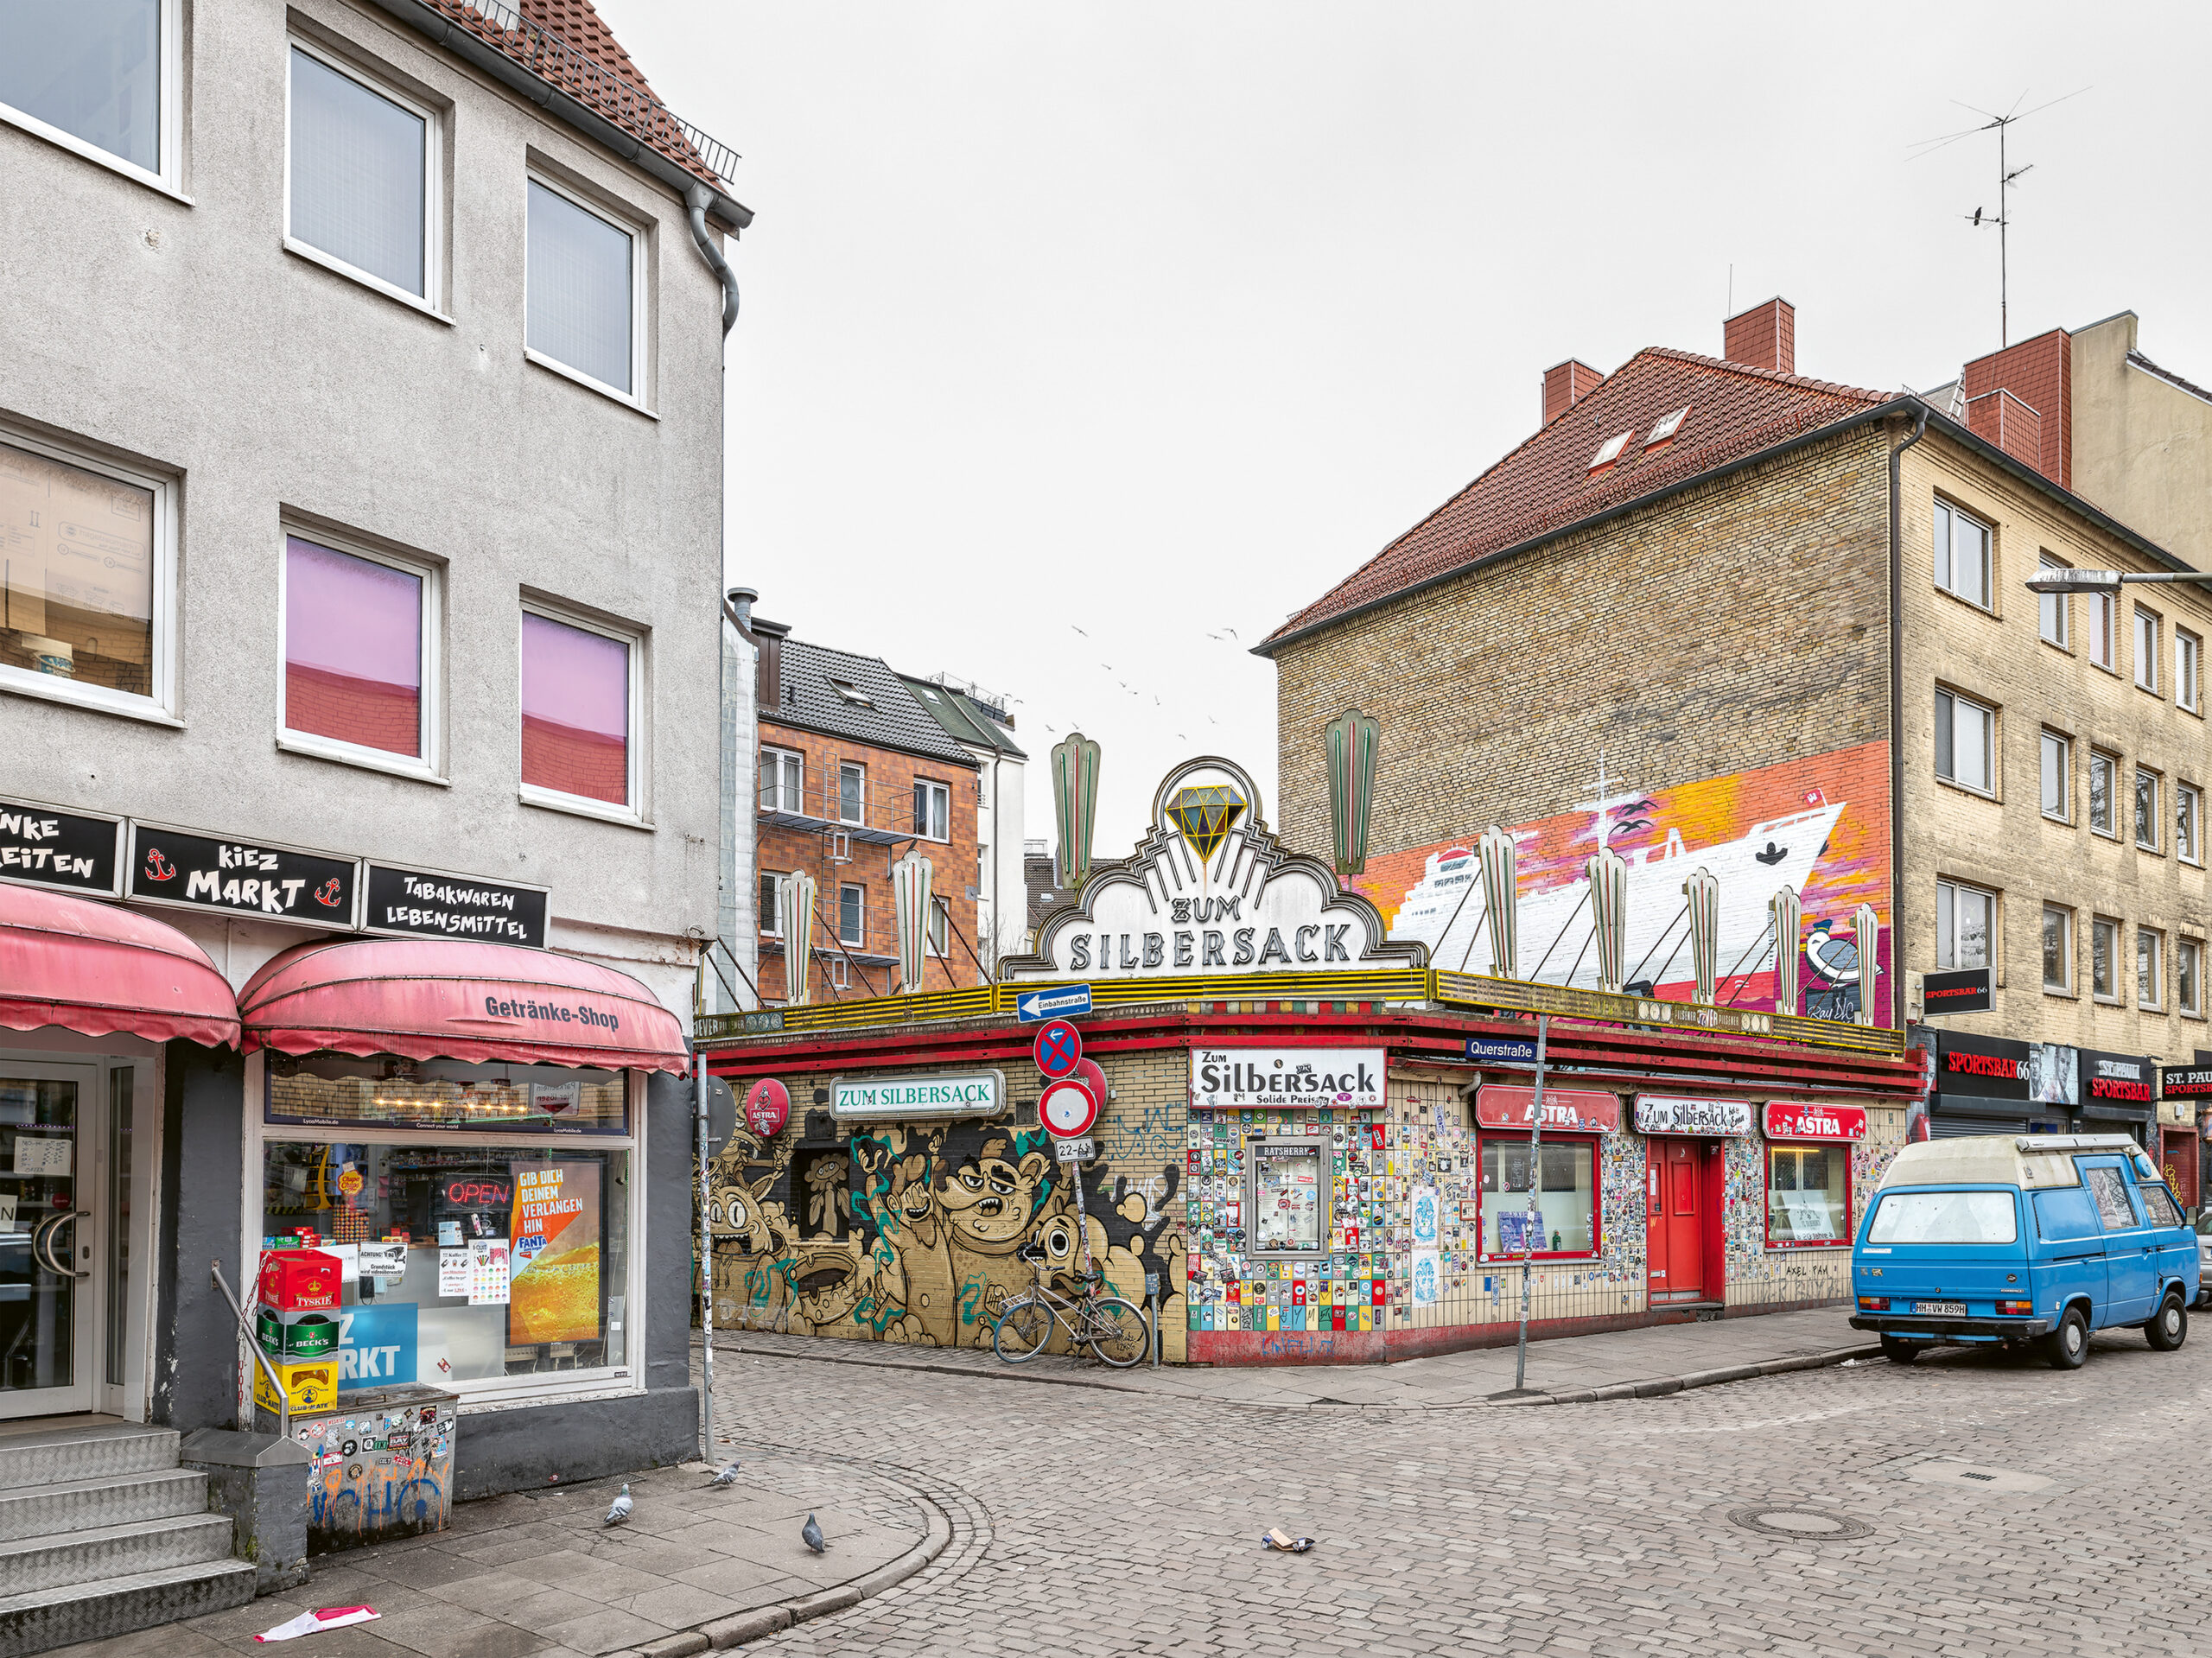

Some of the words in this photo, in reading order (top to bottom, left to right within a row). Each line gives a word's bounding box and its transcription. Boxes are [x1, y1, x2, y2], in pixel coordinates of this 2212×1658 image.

[186, 869, 306, 914] MARKT
[404, 877, 515, 911] TABAKWAREN
[1171, 896, 1242, 924] ZUM
[1070, 924, 1351, 970] SILBERSACK
[1038, 996, 1087, 1009] Einbahnstraße
[486, 996, 620, 1032] Getränke-Shop
[1471, 1041, 1533, 1058] Querstraße
[2166, 1073, 2184, 1085] ST.
[839, 1089, 876, 1106] ZUM
[880, 1083, 991, 1105] SILBERSACK
[2092, 1077, 2151, 1102] SPORTSBAR
[1795, 1116, 1841, 1135] ASTRA
[1264, 1147, 1309, 1156] RATSHERRN
[519, 1172, 537, 1186] GIB
[539, 1169, 563, 1185] DICH
[449, 1183, 509, 1204] OPEN
[521, 1185, 558, 1203] DEINEM
[522, 1197, 583, 1218] VERLANGEN
[524, 1217, 543, 1234] HIN
[518, 1236, 547, 1248] FANTA
[296, 1295, 332, 1306] TYSKIE
[1916, 1303, 1927, 1313] HH
[1932, 1303, 1943, 1313] VW
[1944, 1303, 1966, 1314] 859H
[296, 1337, 329, 1348] BECK'S
[290, 1402, 328, 1412] CLUB-MATE
